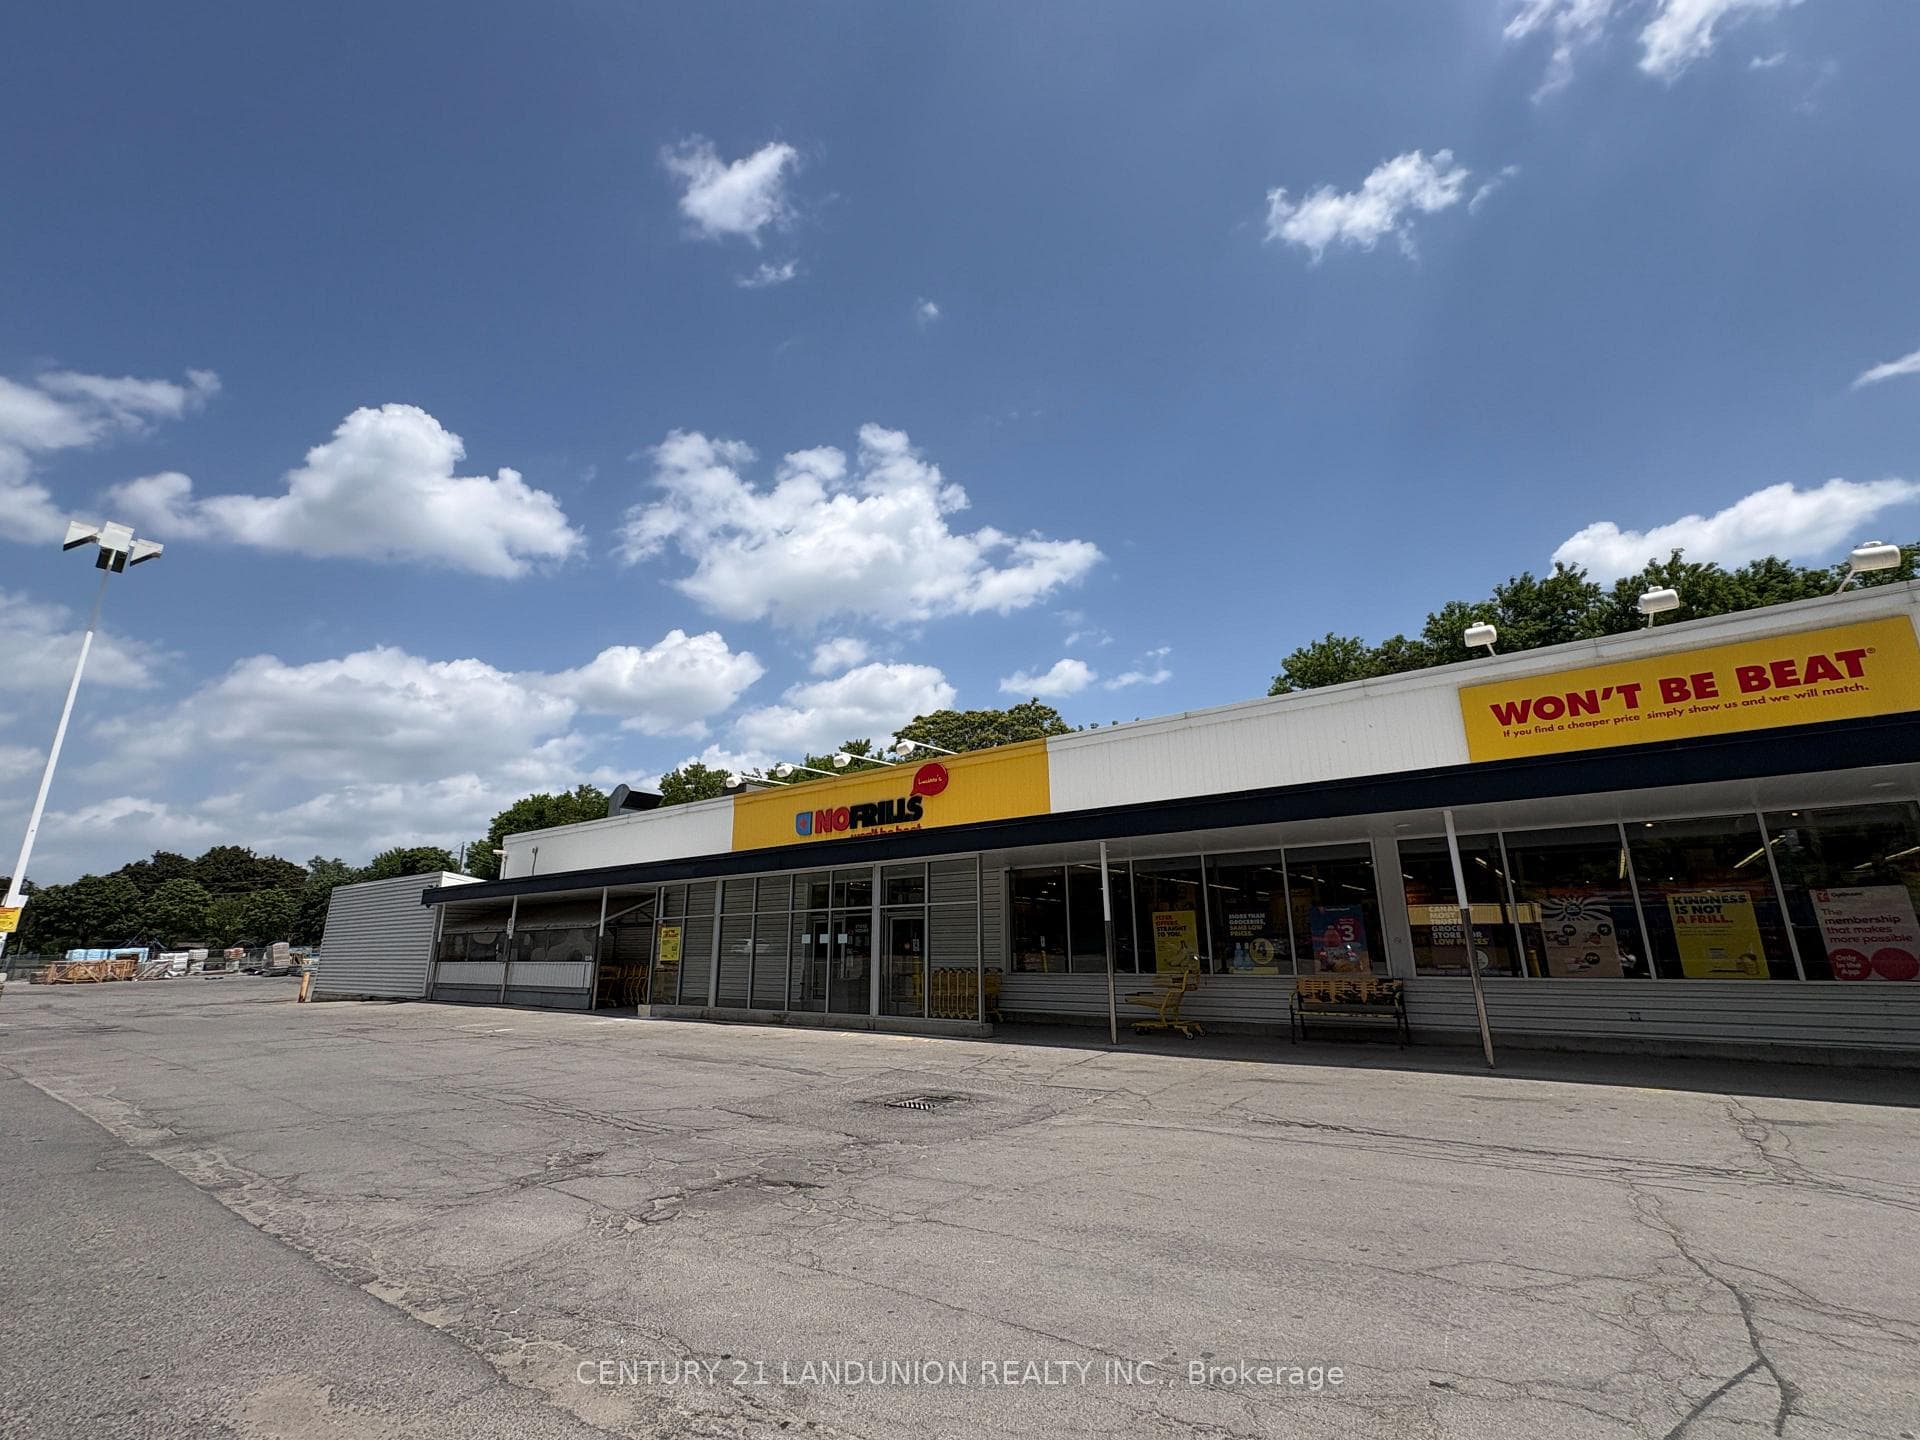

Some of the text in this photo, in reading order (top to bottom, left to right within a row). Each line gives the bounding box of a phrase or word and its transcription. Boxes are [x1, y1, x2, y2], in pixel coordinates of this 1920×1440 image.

[1489, 682, 1642, 727] WON'T
[1658, 672, 1720, 704] BE
[1513, 728, 1532, 739] you
[1534, 724, 1554, 734] find
[1567, 718, 1611, 731] cheaper
[1613, 713, 1640, 726] price
[1646, 706, 1685, 720] simply
[1688, 703, 1720, 714] show
[1724, 700, 1738, 709] us
[1741, 696, 1766, 707] and
[1769, 694, 1790, 703] we
[1793, 688, 1818, 700] will
[1822, 683, 1869, 696] match.
[1672, 894, 1747, 905] KINDNESS
[1675, 905, 1722, 914] IS NOT
[1676, 914, 1733, 924] A FRILL.
[1824, 914, 1901, 924] membership
[1826, 925, 1893, 934] that makes
[1432, 931, 1461, 939] STORE
[1862, 933, 1913, 944] possible
[1434, 938, 1455, 946] LOW
